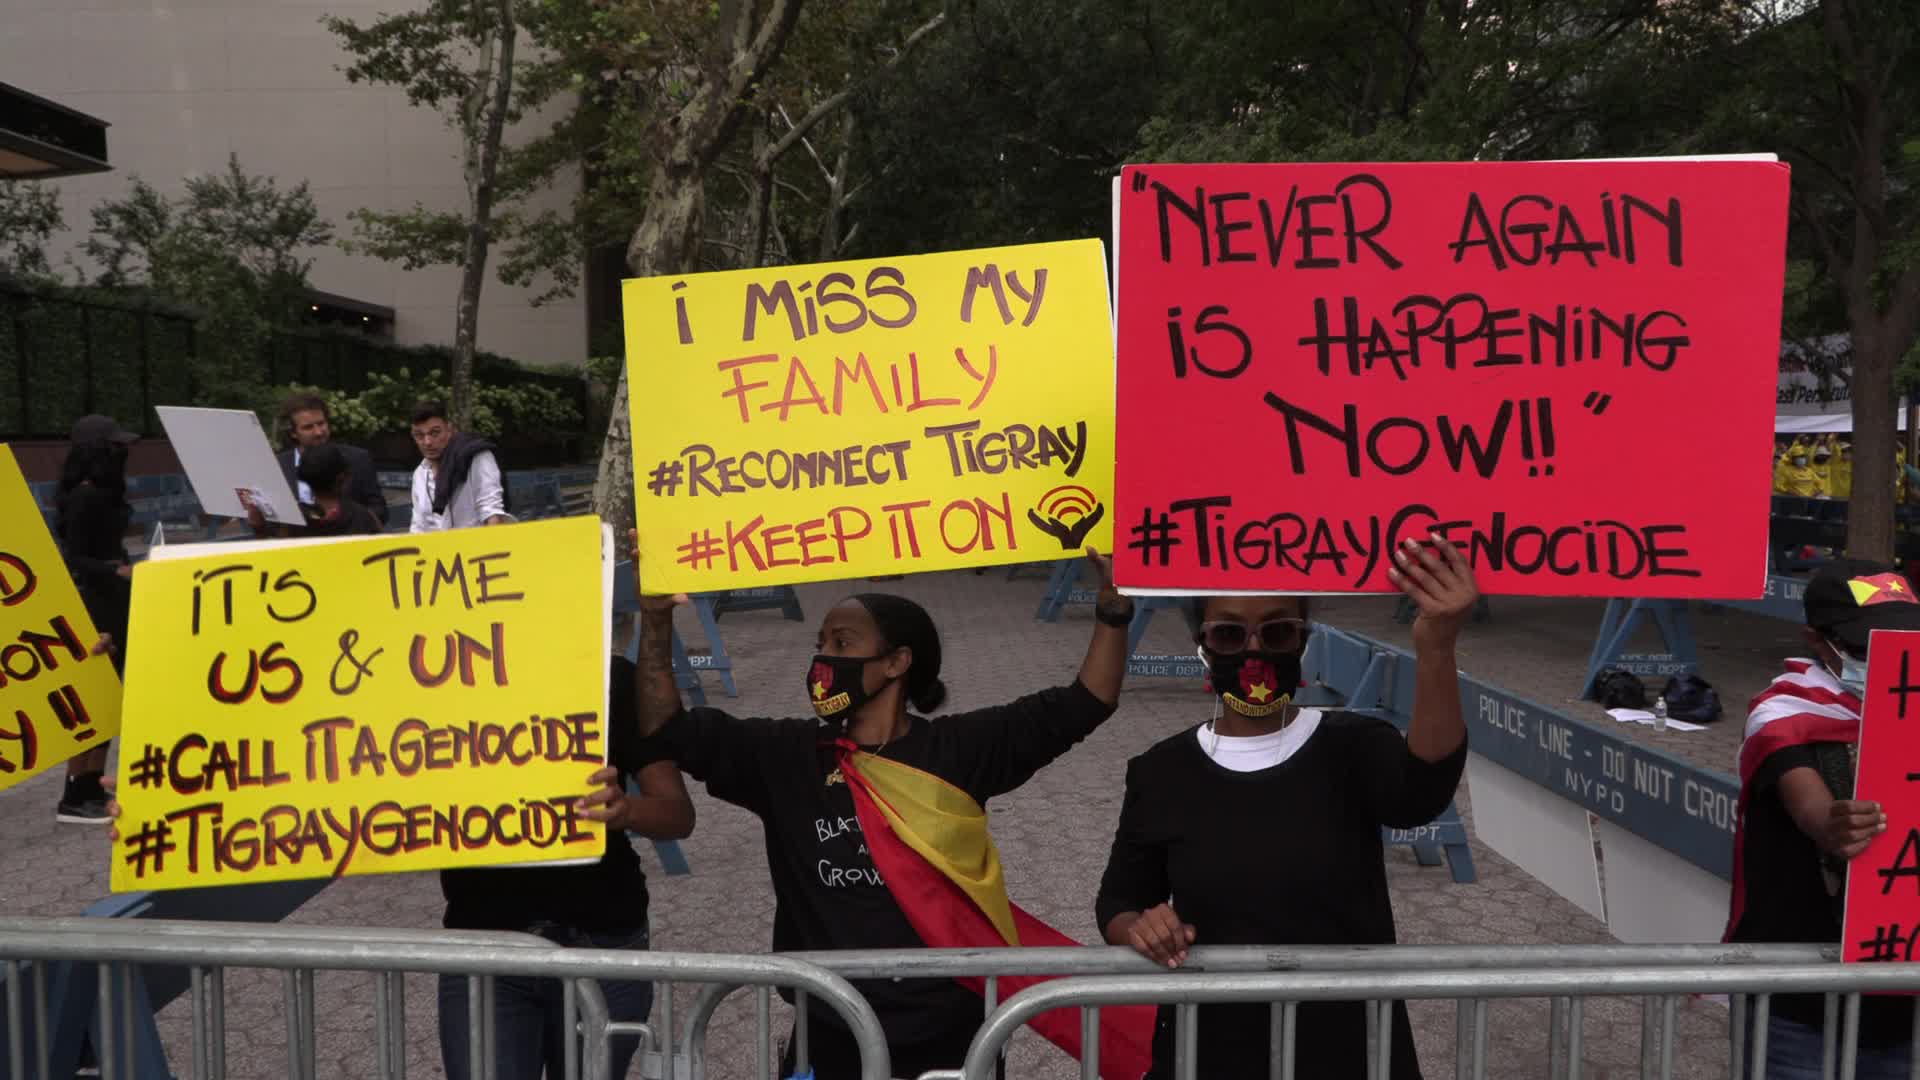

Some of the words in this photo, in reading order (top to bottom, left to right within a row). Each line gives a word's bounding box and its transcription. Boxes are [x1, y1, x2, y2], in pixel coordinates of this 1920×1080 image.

[960, 263, 1048, 327] MY
[717, 344, 997, 423] FAMILY
[647, 439, 911, 497] #RECONNECT
[676, 505, 872, 572] #KEEP
[939, 492, 1017, 554] ON
[0, 615, 88, 688] ON
[207, 641, 303, 704] US
[329, 628, 384, 696] &
[409, 622, 509, 688] UN
[688, 656, 713, 667] EPT
[1479, 694, 1526, 739] POLICE
[1538, 719, 1574, 761] LINE
[1602, 745, 1626, 783] DO
[1634, 758, 1674, 805] NOT
[1565, 767, 1625, 813] NYPD
